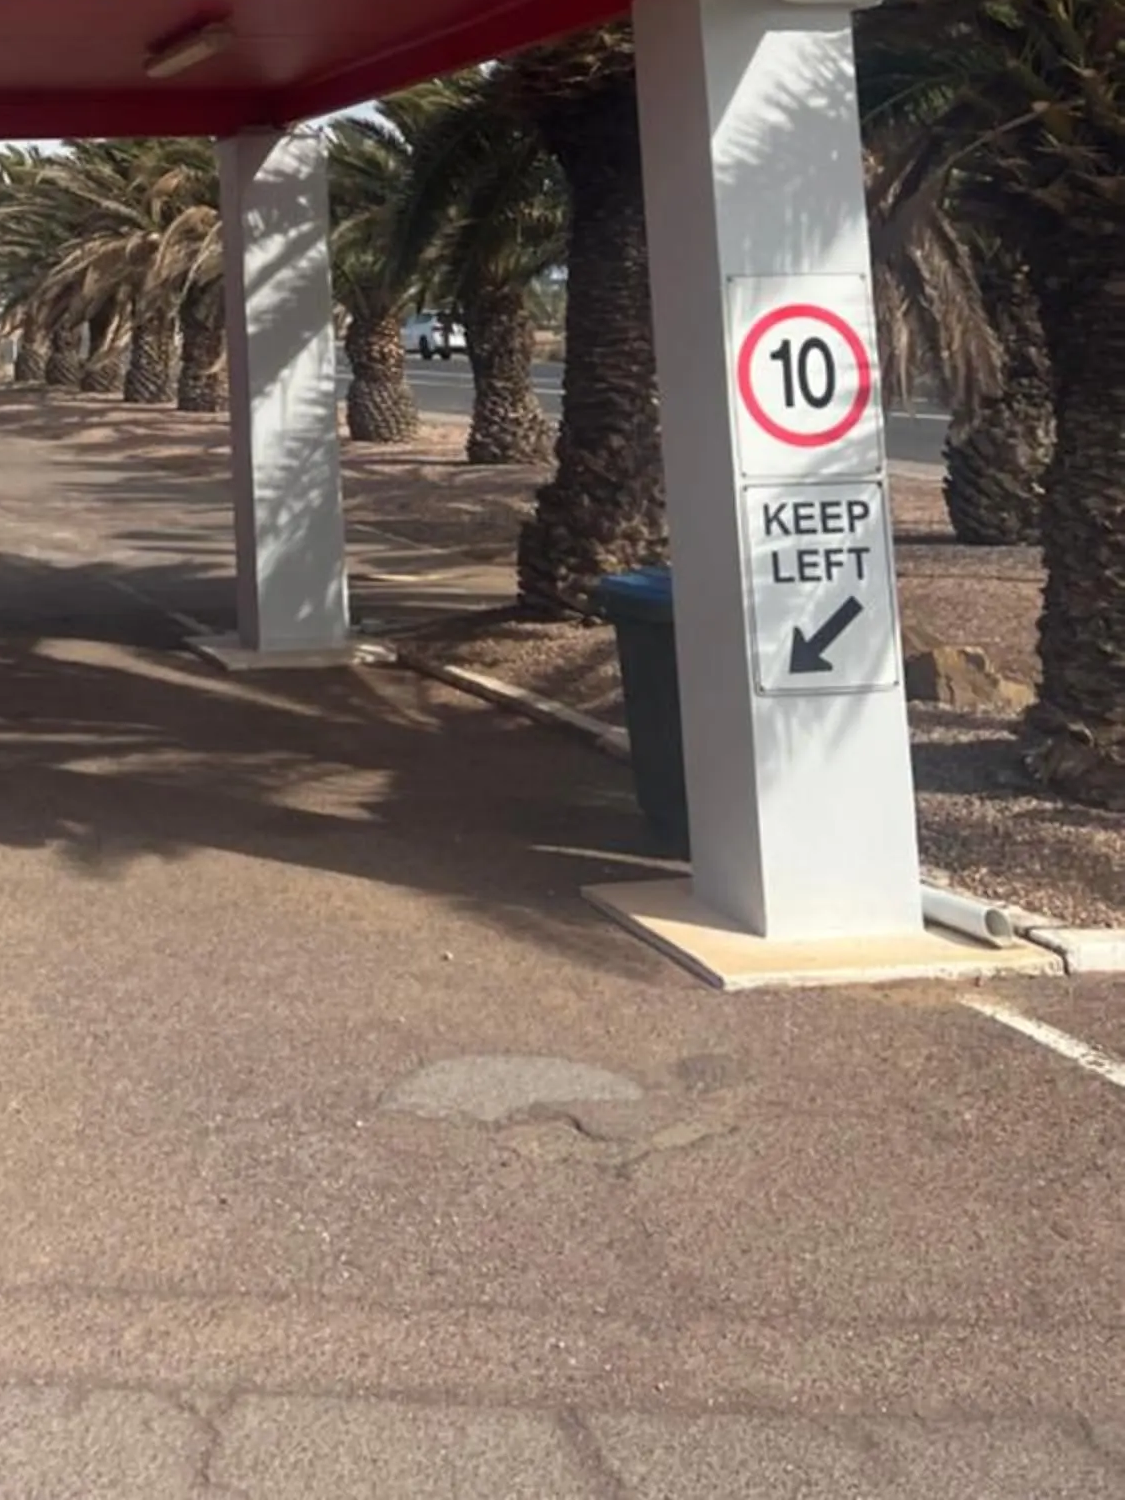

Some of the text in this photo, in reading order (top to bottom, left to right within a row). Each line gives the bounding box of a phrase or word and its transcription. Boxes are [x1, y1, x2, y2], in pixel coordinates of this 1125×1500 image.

[770, 337, 836, 409] 10
[763, 500, 870, 536] KEEP
[771, 547, 871, 584] LEFT
